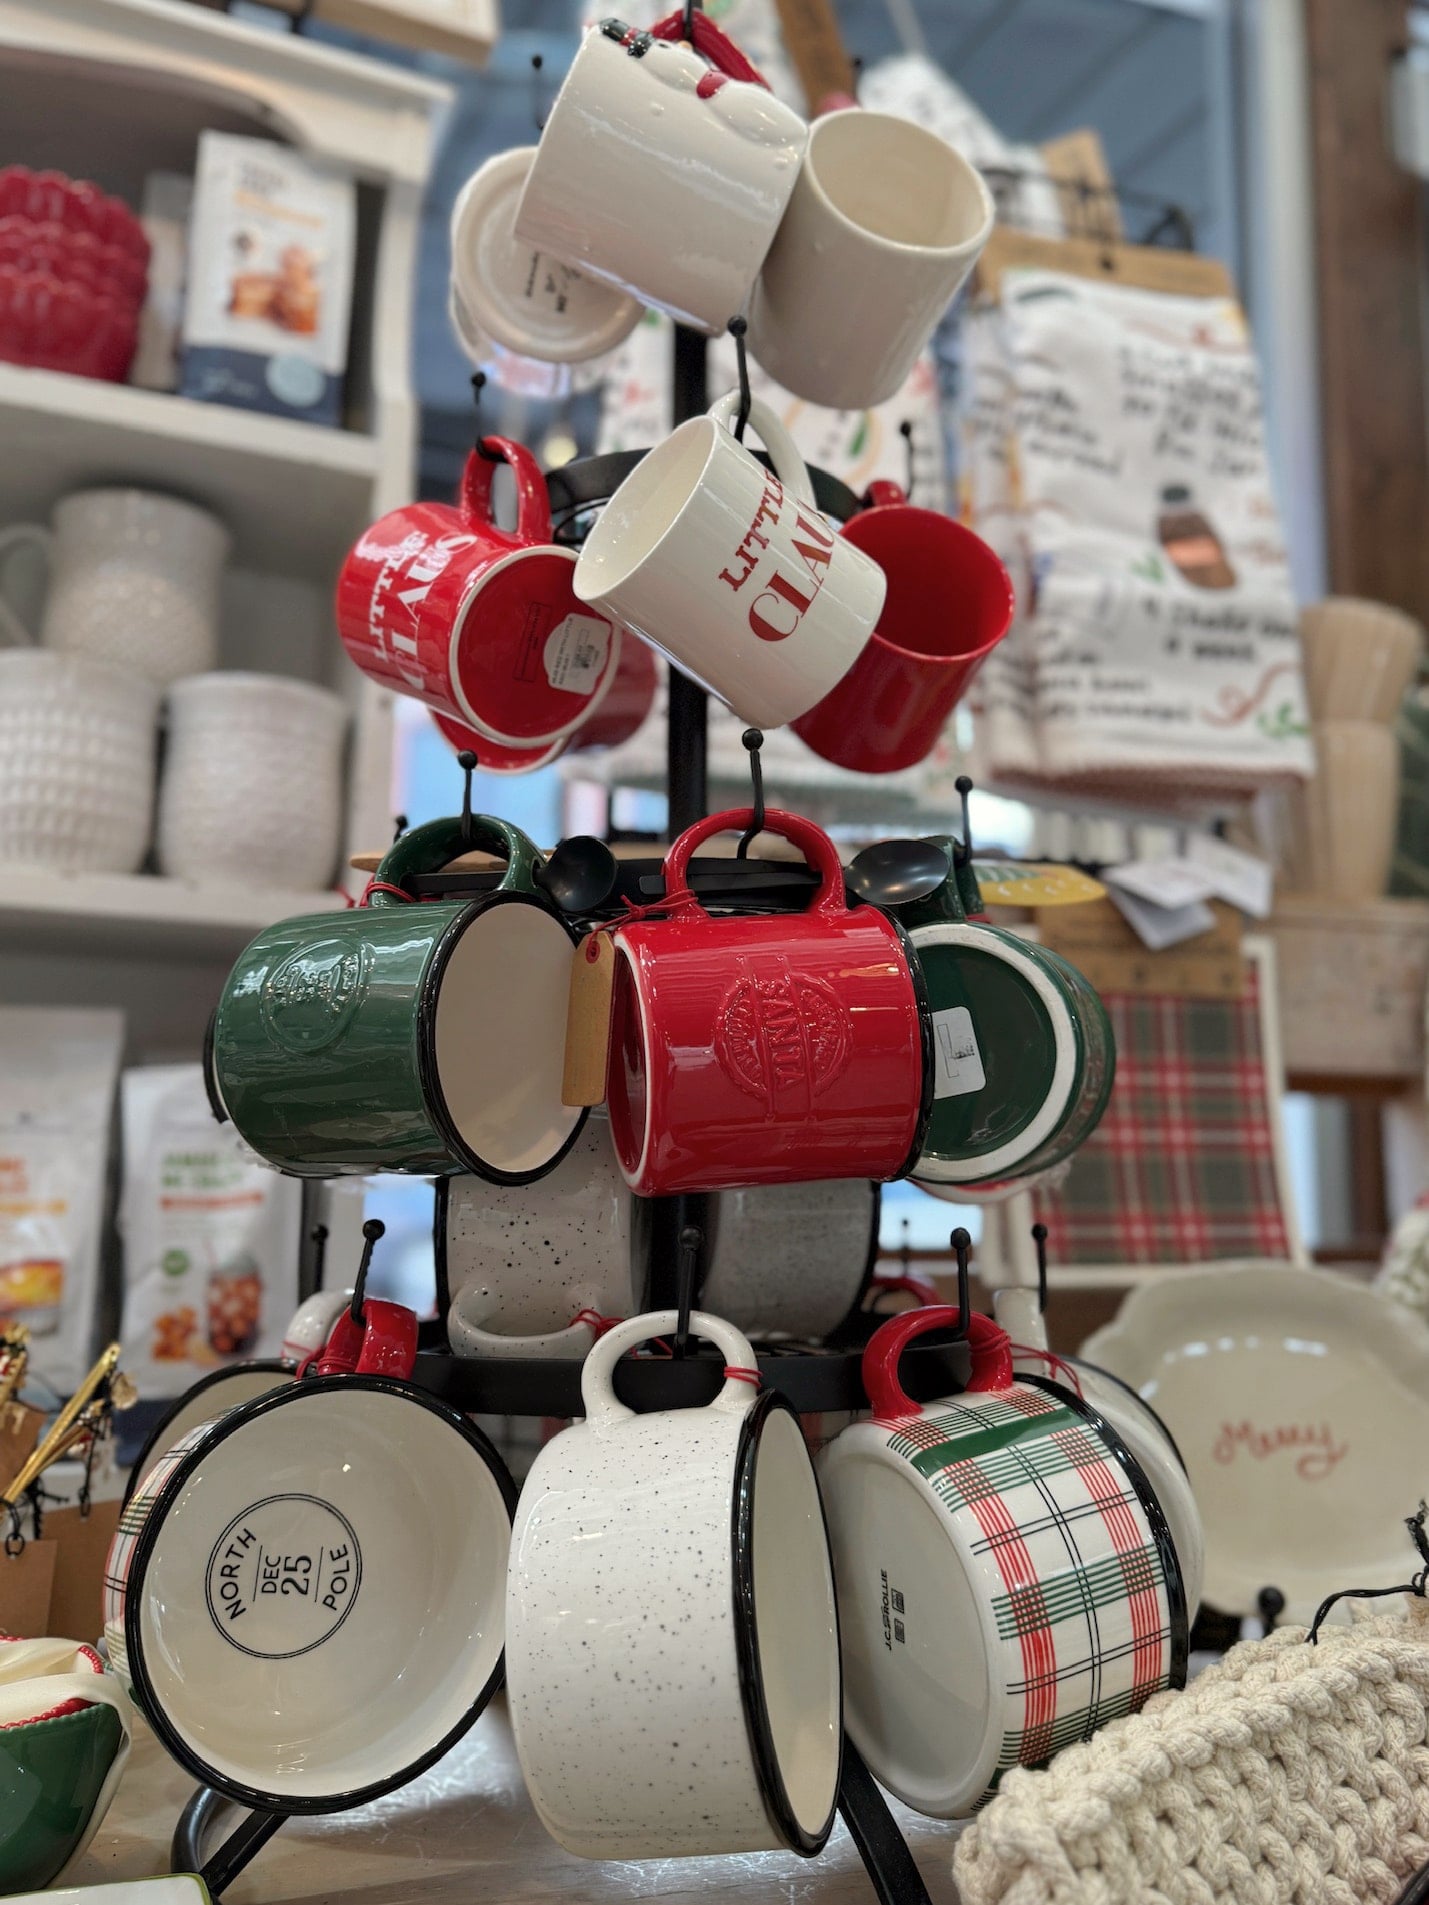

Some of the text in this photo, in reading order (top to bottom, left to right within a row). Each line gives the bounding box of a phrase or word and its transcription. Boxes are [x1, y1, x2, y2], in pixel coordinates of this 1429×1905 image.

[718, 468, 784, 592] LITTLE
[749, 498, 836, 642] CLAU
[369, 530, 429, 664] LITTLE
[391, 532, 478, 690] CLAUS
[220, 1528, 257, 1620] NORTH
[261, 1555, 281, 1594] DEC
[281, 1555, 312, 1595] 25
[322, 1544, 350, 1611] POLE
